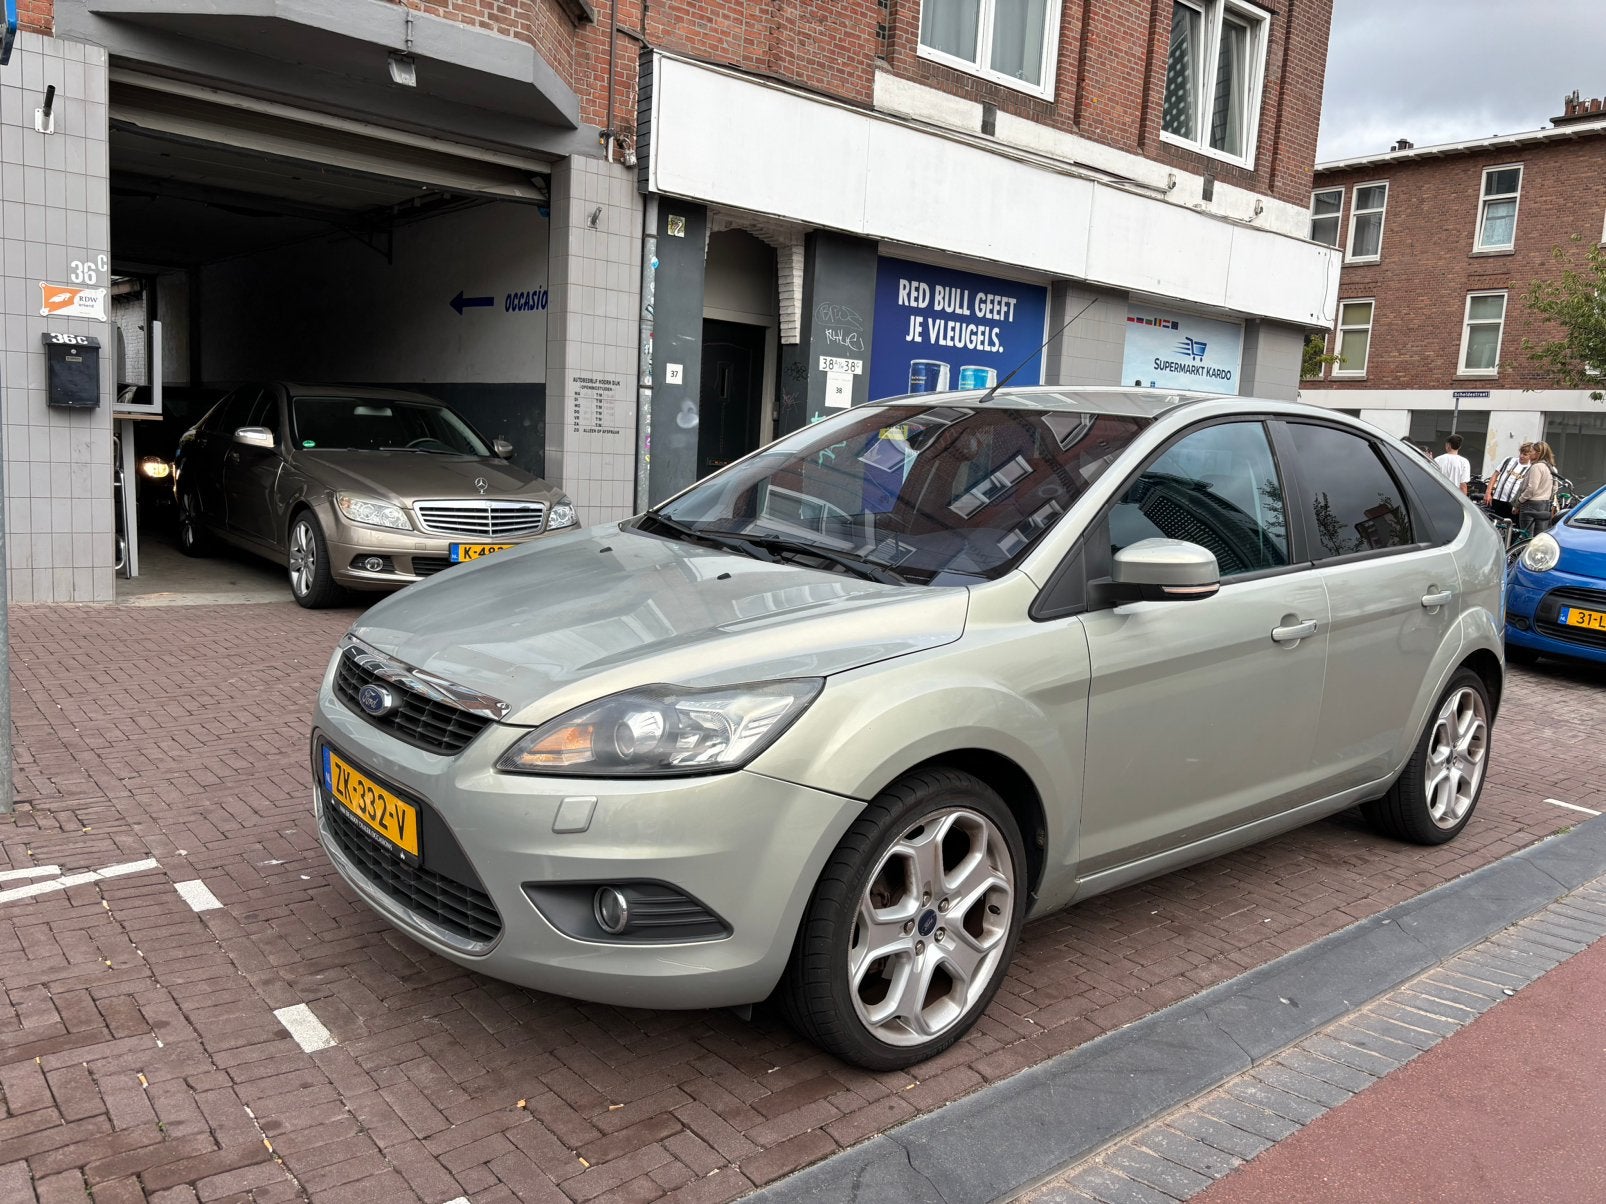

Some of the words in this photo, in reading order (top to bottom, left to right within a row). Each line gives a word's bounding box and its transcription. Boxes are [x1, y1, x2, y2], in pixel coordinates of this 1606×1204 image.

[79, 295, 97, 303] RDW
[898, 278, 930, 309] RED
[934, 284, 971, 316] BULL
[974, 292, 1017, 322] GEEFT
[905, 315, 923, 342] JE
[928, 317, 1004, 353] VLEUGELS.
[670, 370, 679, 378] 37
[1206, 366, 1232, 381] KARDO
[835, 386, 843, 394] 38
[1576, 611, 1606, 628] 31-L
[334, 761, 406, 841] ZK-332-V
